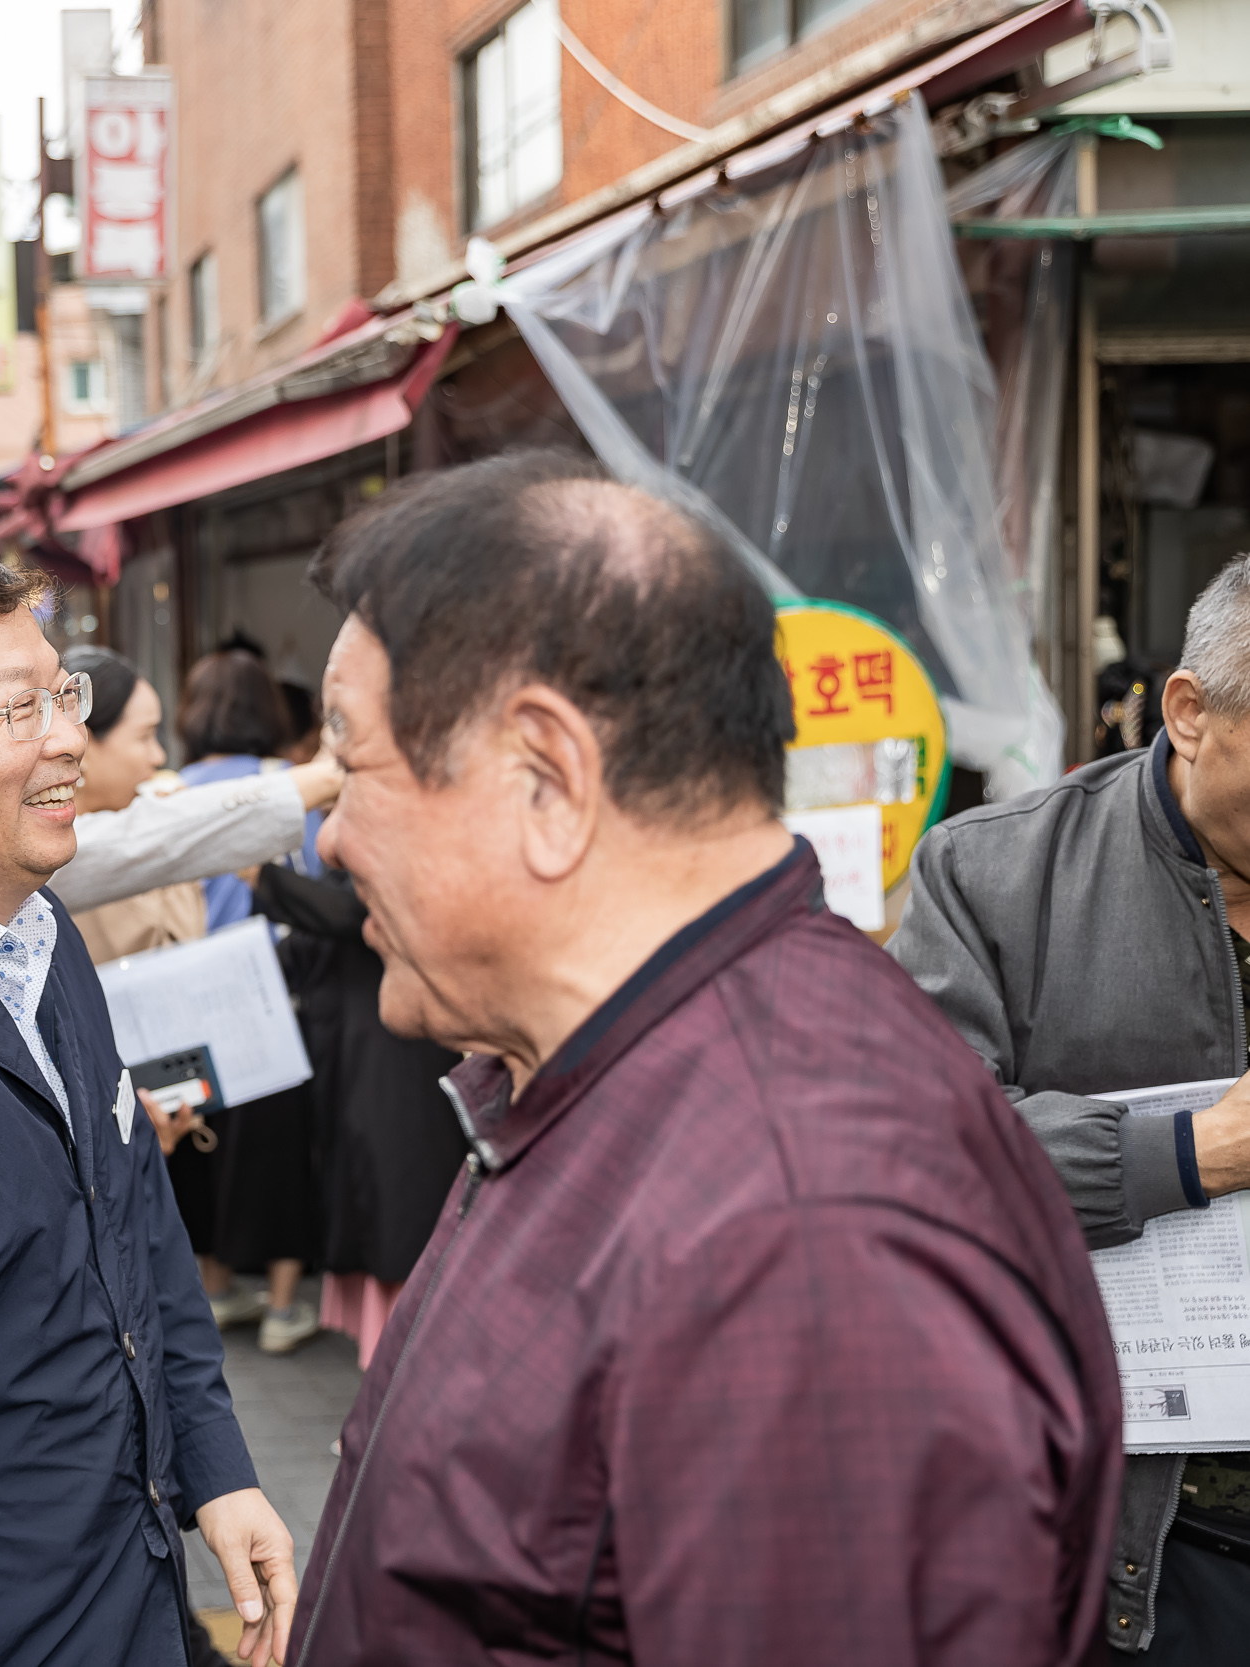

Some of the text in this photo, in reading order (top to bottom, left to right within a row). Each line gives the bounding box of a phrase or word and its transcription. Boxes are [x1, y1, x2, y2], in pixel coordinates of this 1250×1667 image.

[786, 649, 895, 717] 호떡
[1135, 1337, 1175, 1354] 선관위
[1177, 1335, 1205, 1351] 있는
[1208, 1334, 1235, 1350] 뚫려
